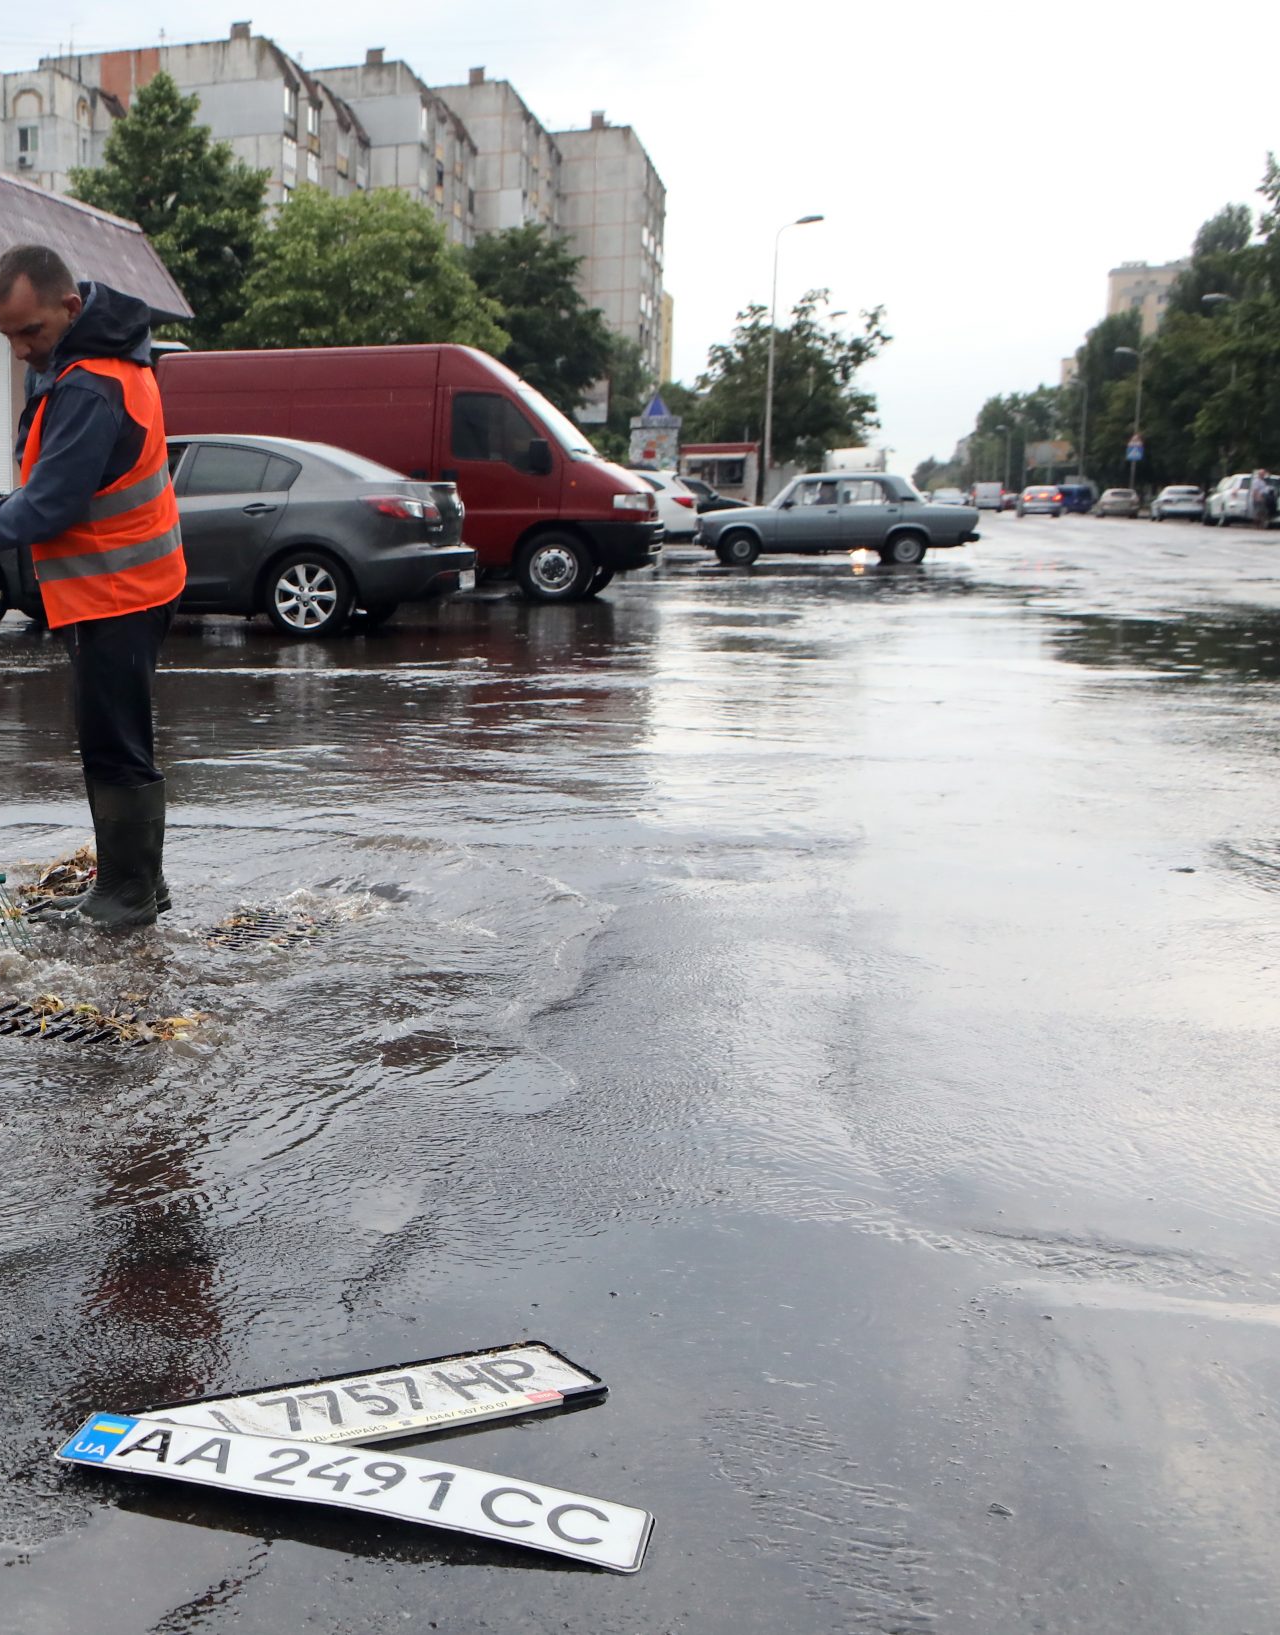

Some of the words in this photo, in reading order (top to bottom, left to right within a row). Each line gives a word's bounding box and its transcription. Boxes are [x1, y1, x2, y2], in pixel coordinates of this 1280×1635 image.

[257, 1375, 424, 1432] 7757
[431, 1358, 536, 1402] HP
[74, 1441, 105, 1456] UA
[115, 1428, 232, 1474] AA
[253, 1447, 457, 1511] 2491
[480, 1487, 611, 1545] CC
